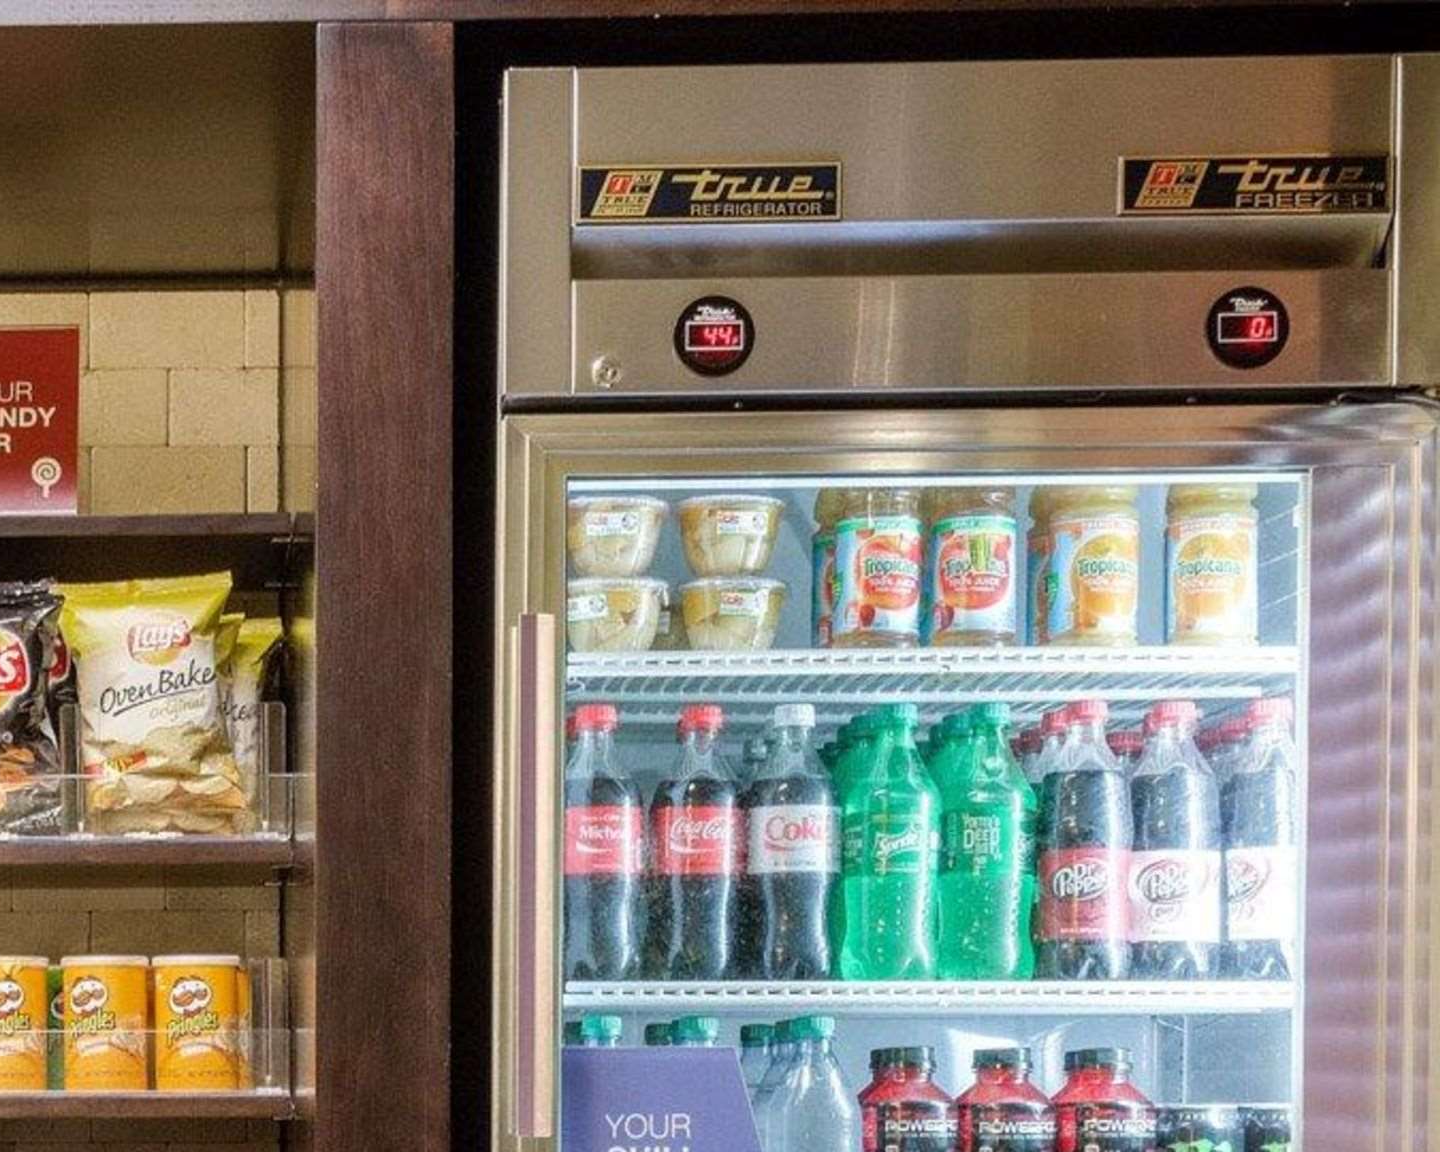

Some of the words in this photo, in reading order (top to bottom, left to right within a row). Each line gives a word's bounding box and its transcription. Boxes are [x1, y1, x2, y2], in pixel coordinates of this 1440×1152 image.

[690, 202, 822, 217] REFRIGERATOR
[1236, 192, 1373, 208] FREEZER
[100, 684, 160, 714] Oven
[159, 658, 216, 695] Bake
[605, 1113, 691, 1139] YOUR
